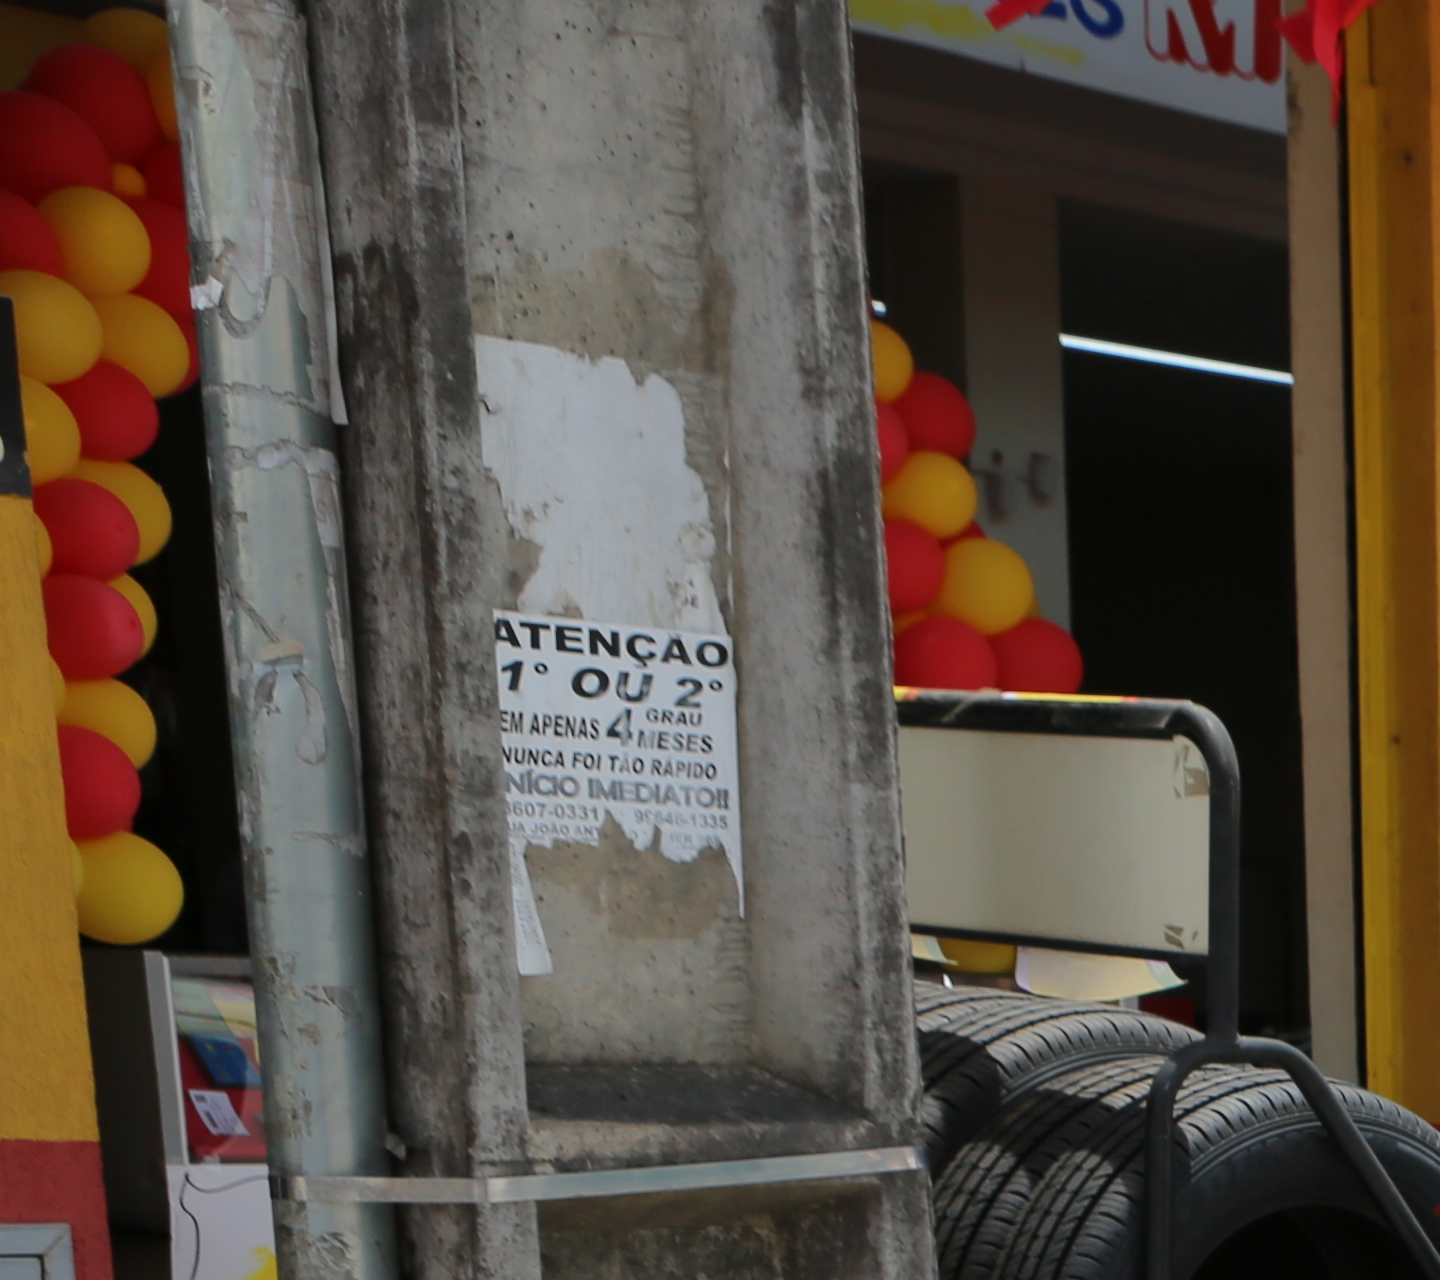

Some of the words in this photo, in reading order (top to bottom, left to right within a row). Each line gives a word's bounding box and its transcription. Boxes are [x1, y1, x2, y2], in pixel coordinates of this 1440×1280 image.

[495, 618, 729, 669] ATENÇÃO
[571, 667, 654, 705] OU
[529, 715, 600, 742] APENAS
[606, 707, 633, 747] 4
[637, 729, 714, 755] MESES
[646, 708, 703, 727] GRAU
[502, 746, 565, 768] NUNCA
[572, 752, 602, 771] FOI
